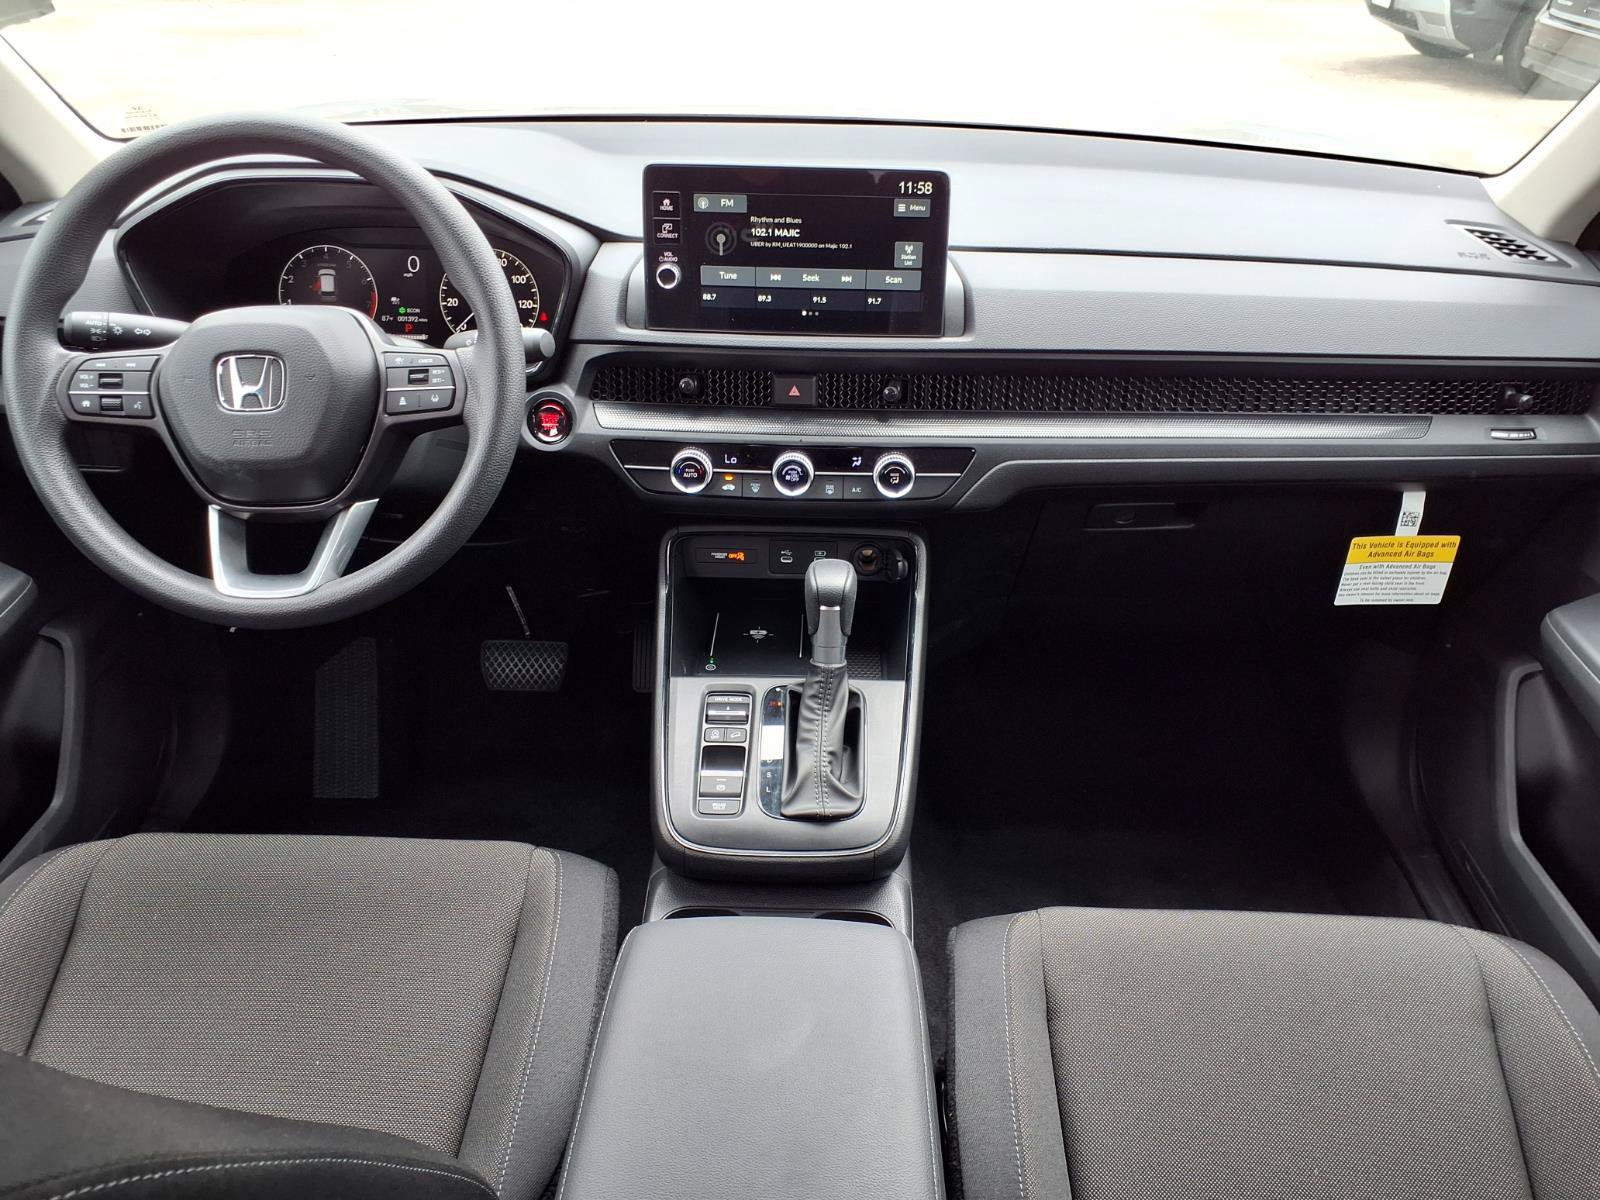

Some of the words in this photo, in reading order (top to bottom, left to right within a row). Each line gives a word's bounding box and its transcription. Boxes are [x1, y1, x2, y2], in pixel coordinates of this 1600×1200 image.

[899, 181, 933, 195] 11:58
[720, 199, 734, 208] FM
[909, 204, 926, 212] Menu
[750, 216, 773, 224] Rhythm
[751, 228, 772, 237] 102.1
[774, 228, 801, 237] MAJIC
[407, 255, 420, 273] 0
[287, 275, 295, 284] 2
[511, 275, 527, 284] 100
[719, 271, 738, 280] Tune
[802, 274, 820, 283] Seek
[885, 276, 903, 285] Scan
[702, 293, 717, 301] 88.7
[758, 295, 772, 303] 89.3
[813, 296, 827, 304] 91.5
[867, 297, 882, 305] 91.7
[446, 298, 459, 307] 20
[518, 300, 533, 309] 120
[405, 323, 413, 332] P
[724, 453, 738, 464] Lo
[1405, 541, 1439, 549] Equipped
[1367, 550, 1402, 558] Advanced
[1416, 550, 1435, 558] Bags
